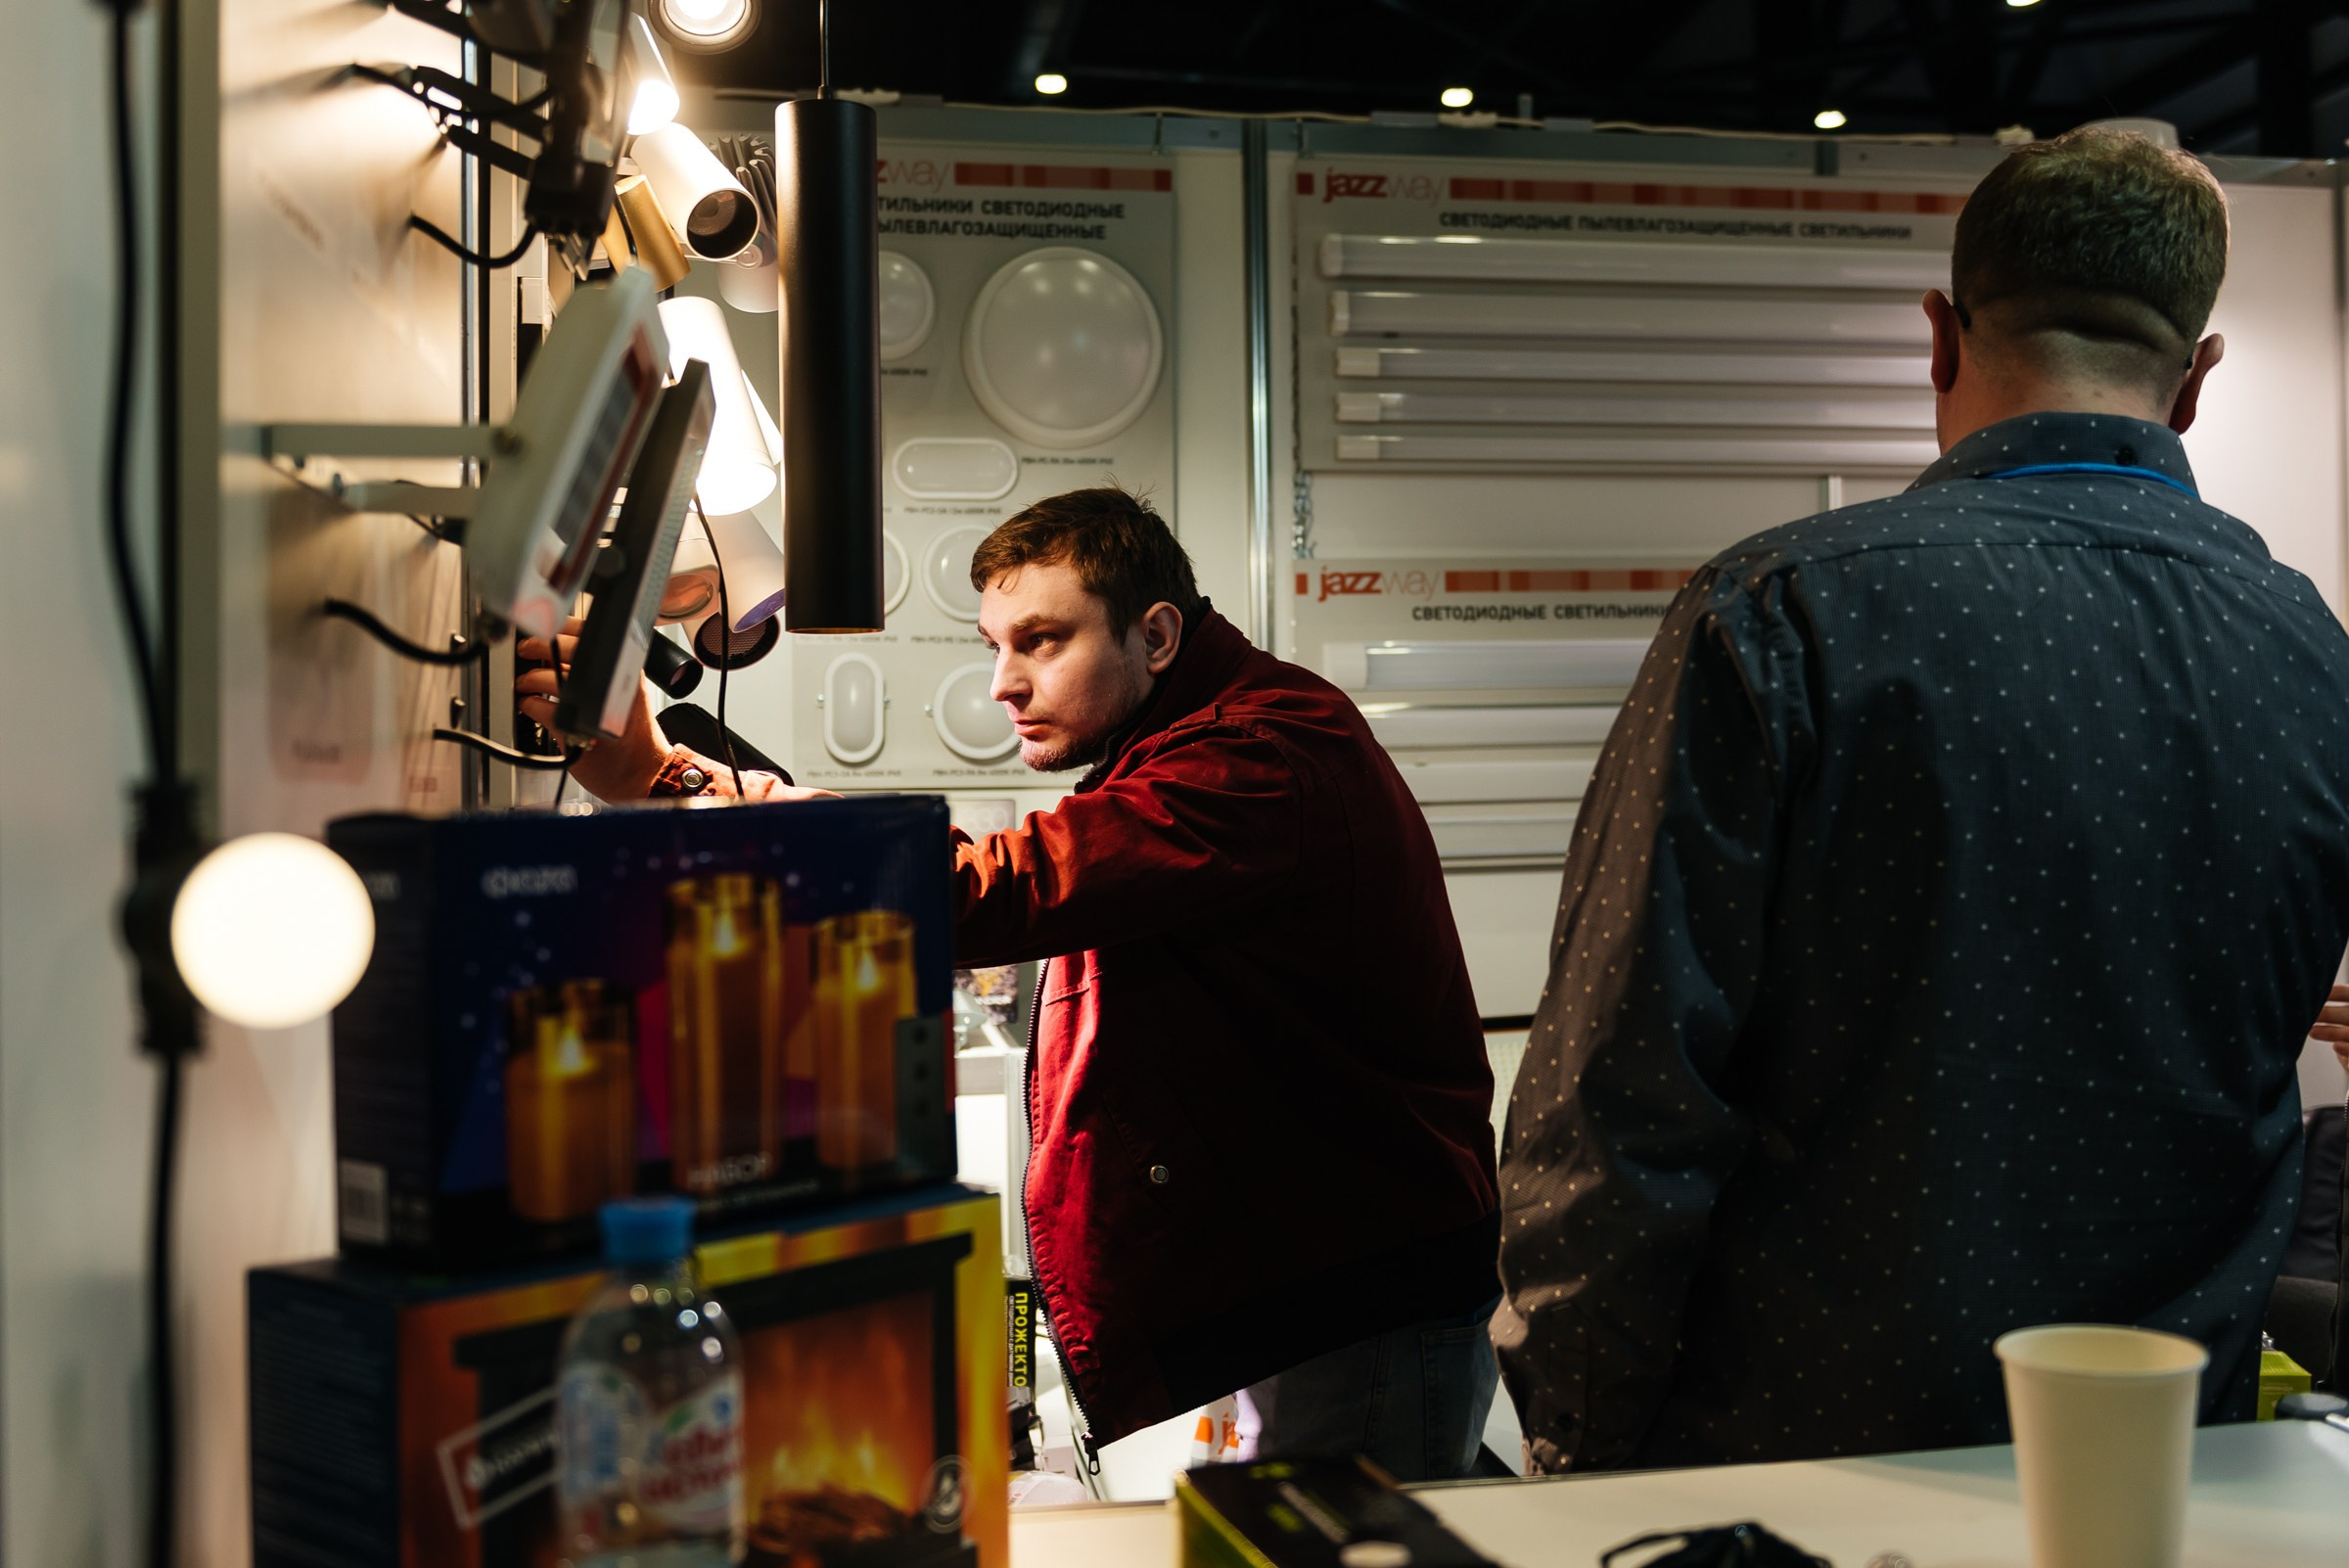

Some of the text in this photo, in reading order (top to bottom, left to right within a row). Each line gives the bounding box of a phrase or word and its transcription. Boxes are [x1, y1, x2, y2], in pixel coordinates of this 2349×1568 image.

[877, 161, 950, 194] zway
[1323, 166, 1445, 207] jazzway
[877, 197, 1125, 219] ТИЛЬНИКИ СВЕТОДИОДНЫЕ
[878, 218, 1107, 240] ЫЛЕВЛАГОЗАЩИЩЕННЫЕ
[1439, 211, 1572, 231] СВЕТОДИОДНЫЕ
[1799, 221, 1912, 240] СВЕТИЛЬНИКИ
[1317, 566, 1441, 602] jazzway
[1411, 604, 1547, 622] СВЕТОДИОДНЫЕ
[1014, 1292, 1029, 1387] ПРОЖЕКТО
